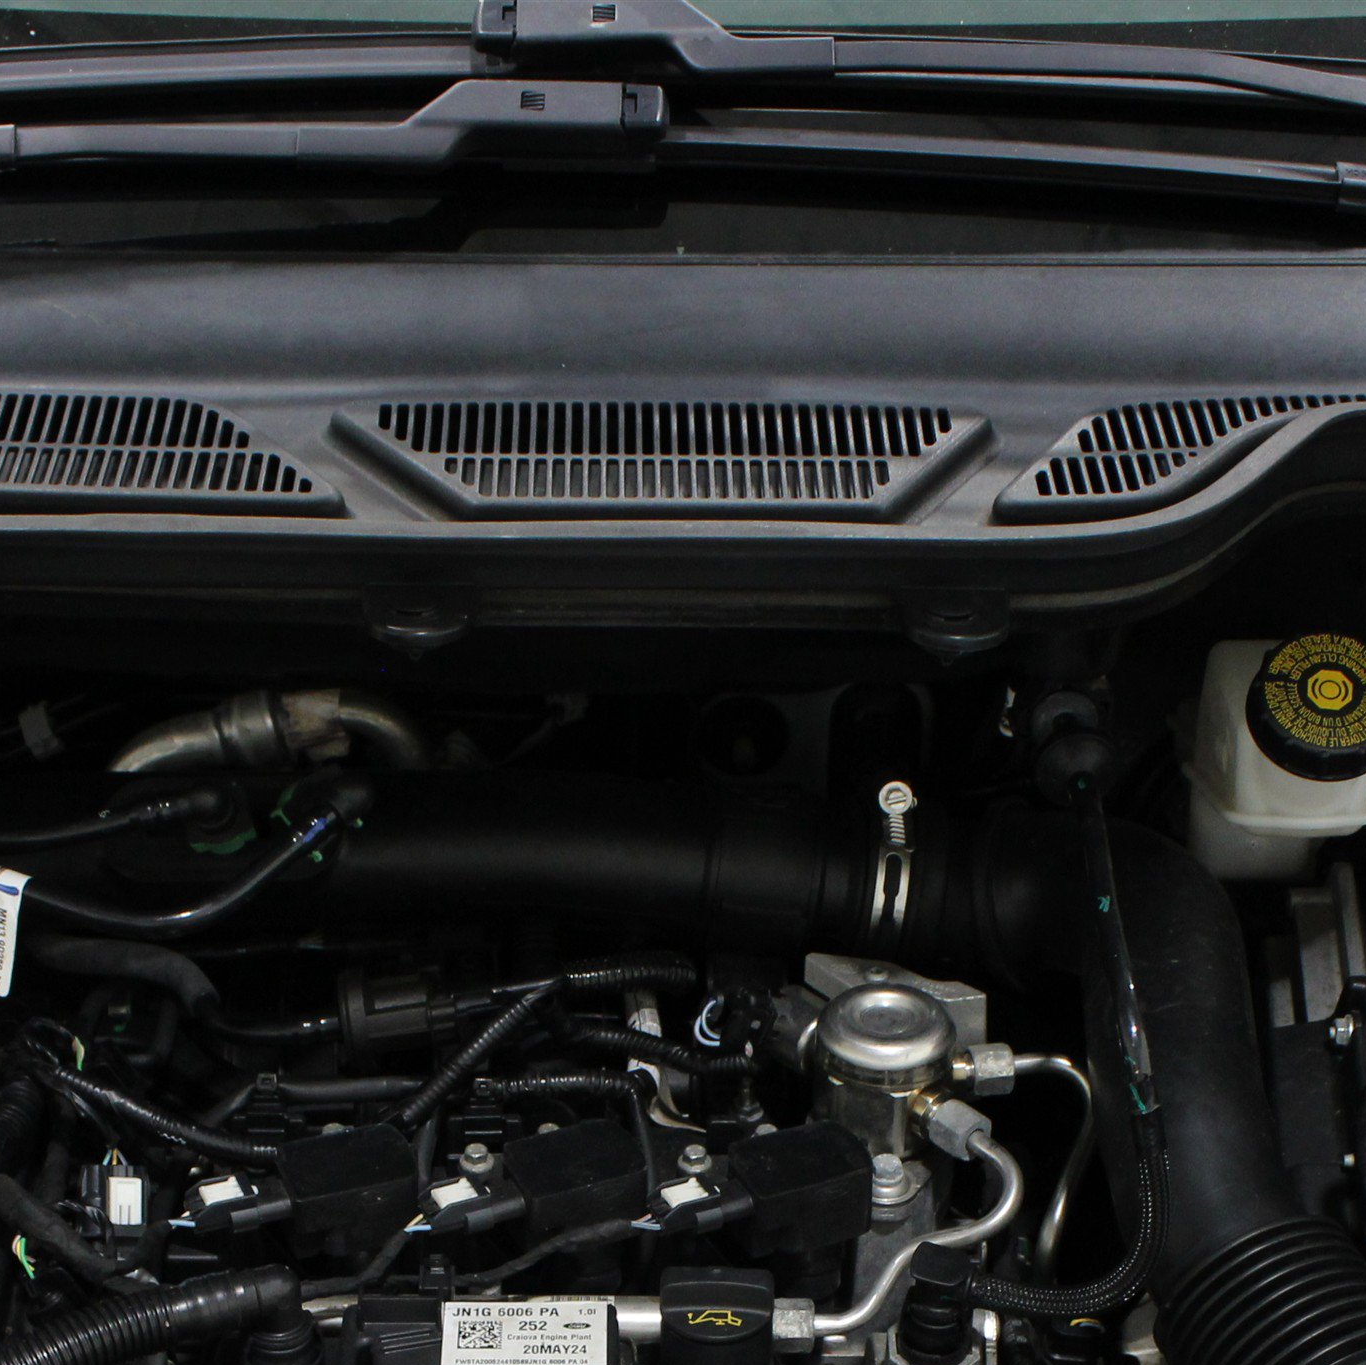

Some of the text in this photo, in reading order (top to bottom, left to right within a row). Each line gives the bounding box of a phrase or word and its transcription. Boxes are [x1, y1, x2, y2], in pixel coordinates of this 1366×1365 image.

[1299, 633, 1332, 647] SEALED
[1333, 634, 1341, 644] A
[1309, 652, 1338, 664] CLEAN
[1290, 659, 1312, 681] FILLER
[1298, 705, 1322, 725] BIDON
[1294, 717, 1307, 728] DE
[1290, 725, 1327, 747] BOUCHON
[1335, 727, 1347, 739] DU
[1328, 737, 1340, 748] LE
[452, 1307, 492, 1317] JN1G
[497, 1307, 534, 1317] 6006
[539, 1307, 560, 1317] PA
[518, 1320, 548, 1331] 252
[507, 1333, 592, 1342] Craiova Engine Plant
[522, 1344, 587, 1355] 20MAY24
